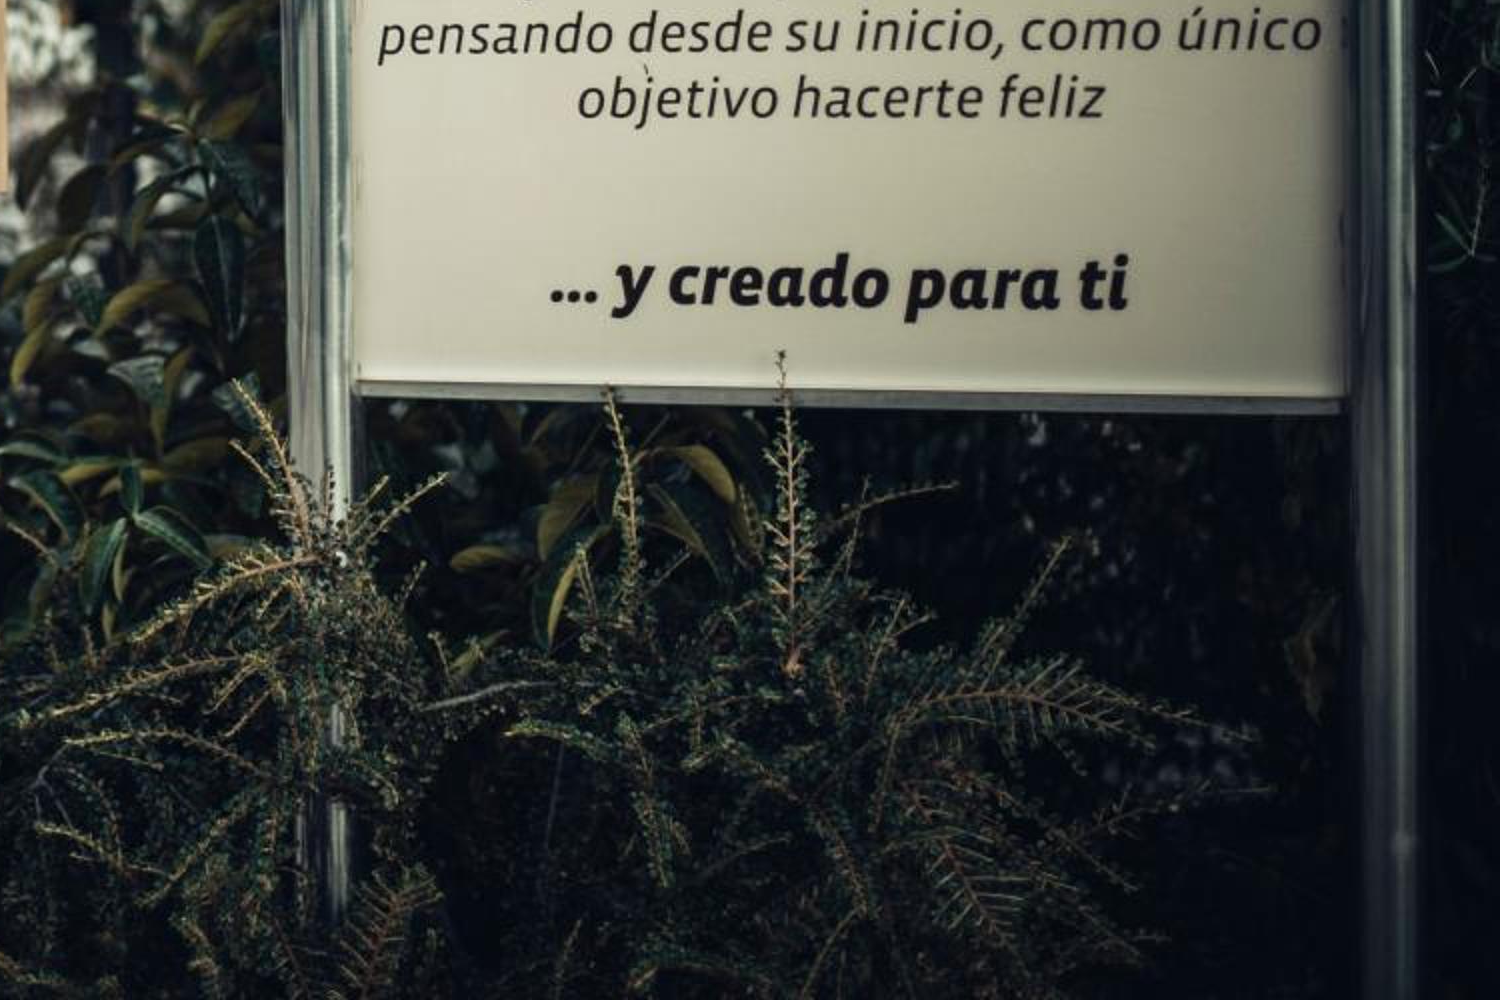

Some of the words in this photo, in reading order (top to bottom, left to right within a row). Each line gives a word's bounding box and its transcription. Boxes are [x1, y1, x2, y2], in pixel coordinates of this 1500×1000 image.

[377, 10, 613, 67] pensando
[628, 9, 773, 54] desde
[785, 20, 841, 53] su
[855, 8, 1004, 61] inicio,
[1021, 17, 1161, 52] como
[1177, 6, 1322, 52] único
[577, 75, 779, 131] objetivo
[793, 74, 984, 119] hacerte
[999, 73, 1107, 119] feliz
[668, 251, 891, 310] creado
[904, 267, 1061, 325] para
[1079, 252, 1130, 312] ti
